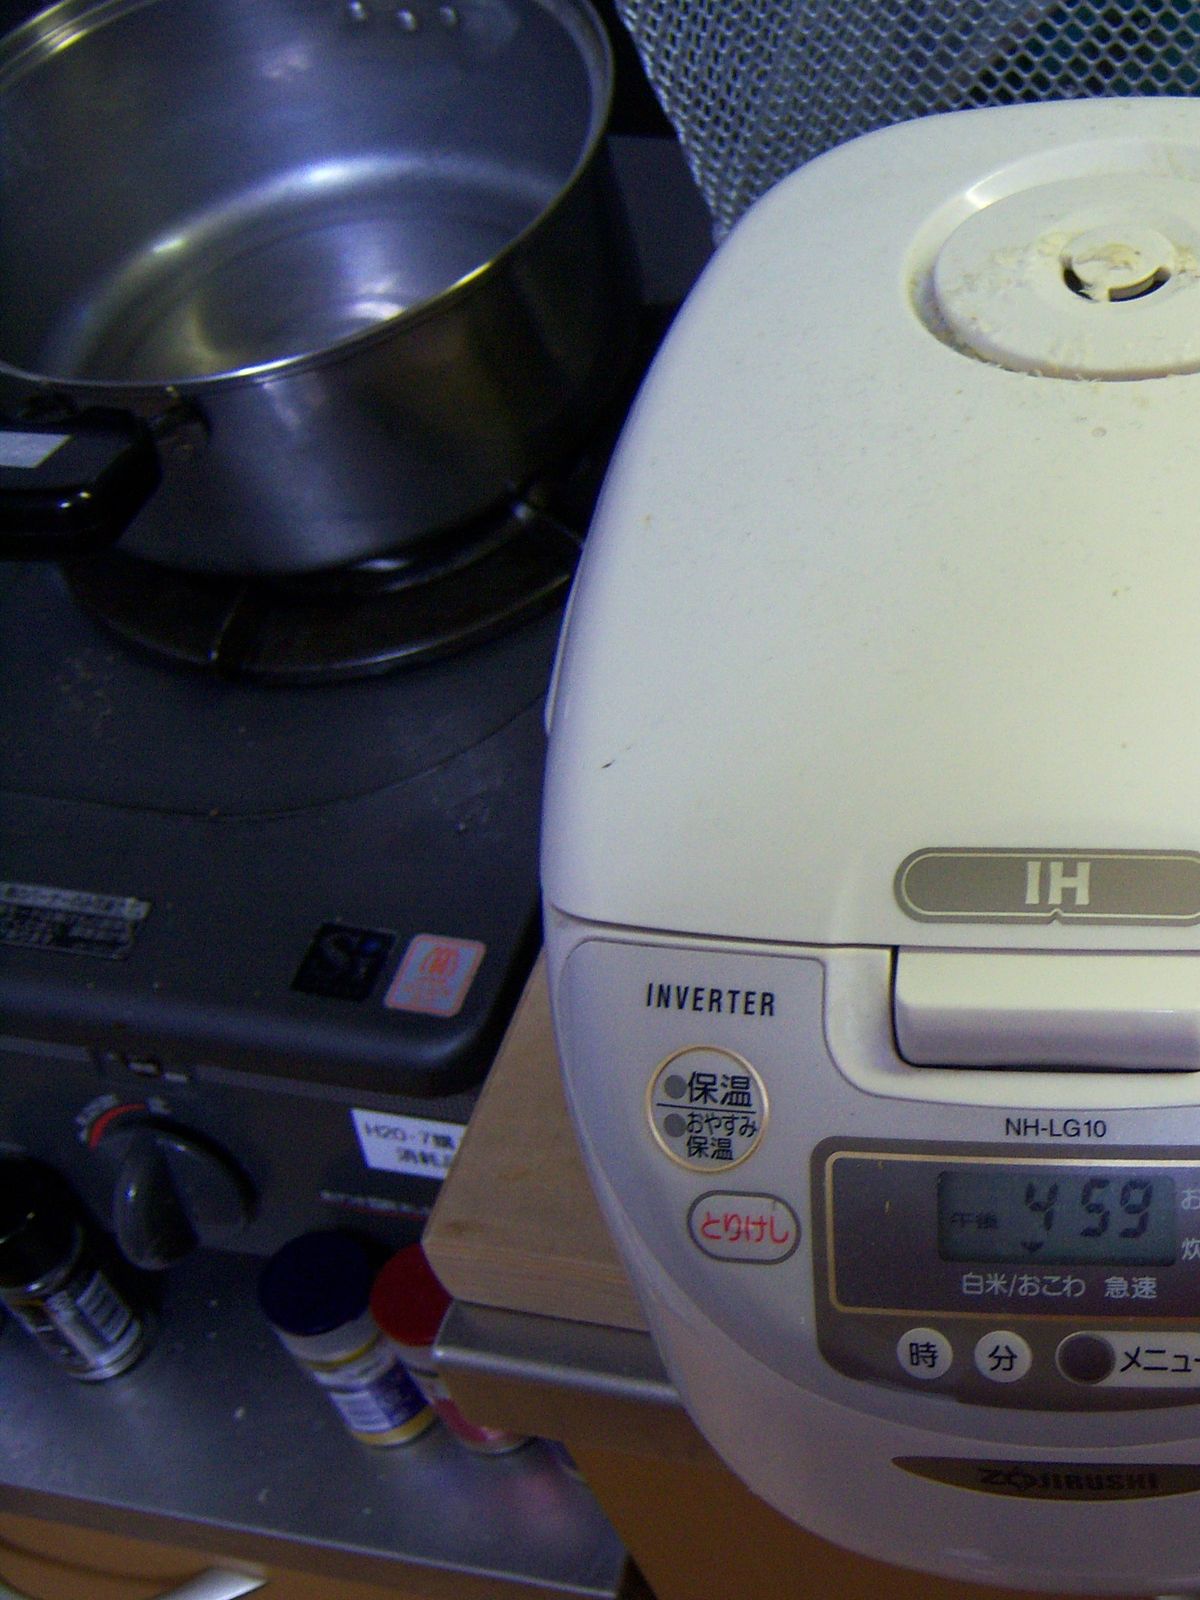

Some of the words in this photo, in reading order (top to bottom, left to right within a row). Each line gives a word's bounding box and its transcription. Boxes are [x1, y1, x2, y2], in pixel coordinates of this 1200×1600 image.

[1025, 861, 1090, 905] IH
[646, 982, 775, 1017] INVERTER
[688, 1071, 753, 1108] 保温
[686, 1112, 759, 1138] おやすみ
[1005, 1118, 1107, 1138] NH-LG10
[687, 1135, 734, 1161] 保温
[701, 1212, 789, 1244] とりけし
[961, 1273, 1087, 1298] 白米/おこわ
[1104, 1276, 1158, 1299] 急速
[909, 1342, 939, 1368] 時
[988, 1345, 1018, 1371] 分
